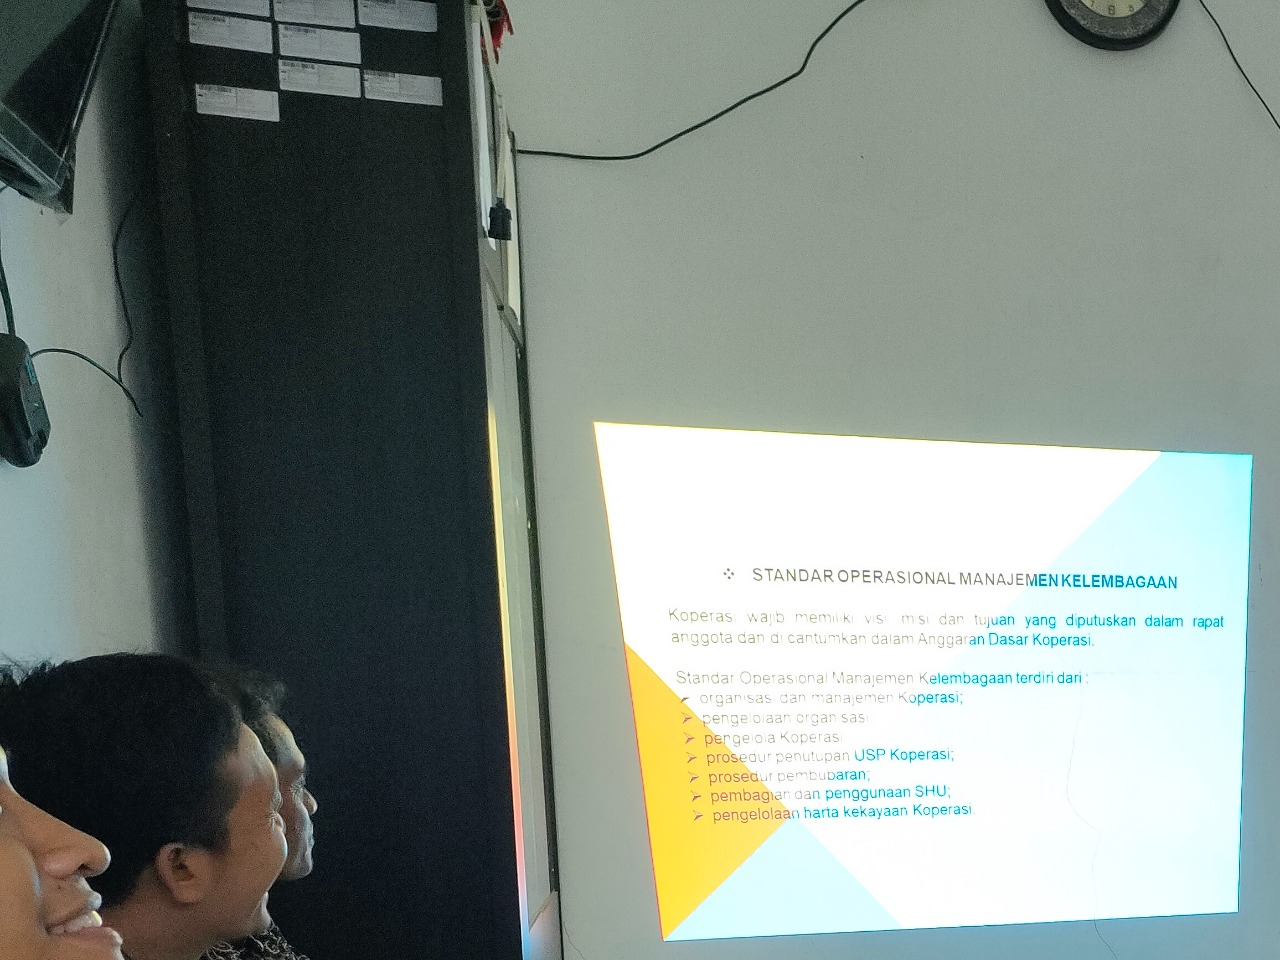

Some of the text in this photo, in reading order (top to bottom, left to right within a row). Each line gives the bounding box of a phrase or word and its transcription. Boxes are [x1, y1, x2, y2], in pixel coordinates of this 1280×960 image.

[753, 567, 1178, 590] STANDAR OPERASIONAL MANAJEMEN KELEMBAGAAN
[668, 607, 737, 625] Koperasi
[747, 611, 785, 627] wajib
[795, 611, 854, 625] memiliki
[939, 612, 965, 626] dan
[974, 613, 1016, 629] tujuan
[1025, 615, 1057, 629] yang
[1065, 613, 1136, 630] diputuskan
[1145, 614, 1184, 628] dalam
[1192, 616, 1225, 631] rapat
[671, 631, 733, 647] anggota
[737, 631, 765, 645] dan
[787, 631, 867, 645] cantumkan
[871, 632, 914, 646] dalam
[917, 632, 985, 649] Anggaran
[989, 633, 1029, 646] Dasar
[1032, 633, 1095, 648] Koperasi.
[676, 670, 734, 685] Standar
[740, 671, 828, 687] Operasional
[832, 671, 914, 688] Manajemen
[919, 671, 1013, 688] Kelembagaan
[1016, 672, 1054, 685] terdiri
[1057, 672, 1082, 685] dari
[700, 691, 964, 708] organisas dan manajemen Koperasi;
[702, 711, 869, 727] pengelolaan organsasi
[704, 732, 776, 747] pengelola
[706, 747, 955, 767] prosedur penutupan USP Koperasi;
[708, 770, 774, 787] prosedur
[711, 784, 951, 806] pembagian dan penggunaan SHU;
[713, 806, 800, 825] pengelolaan
[804, 805, 839, 820] harta
[843, 804, 908, 820] kekayaan
